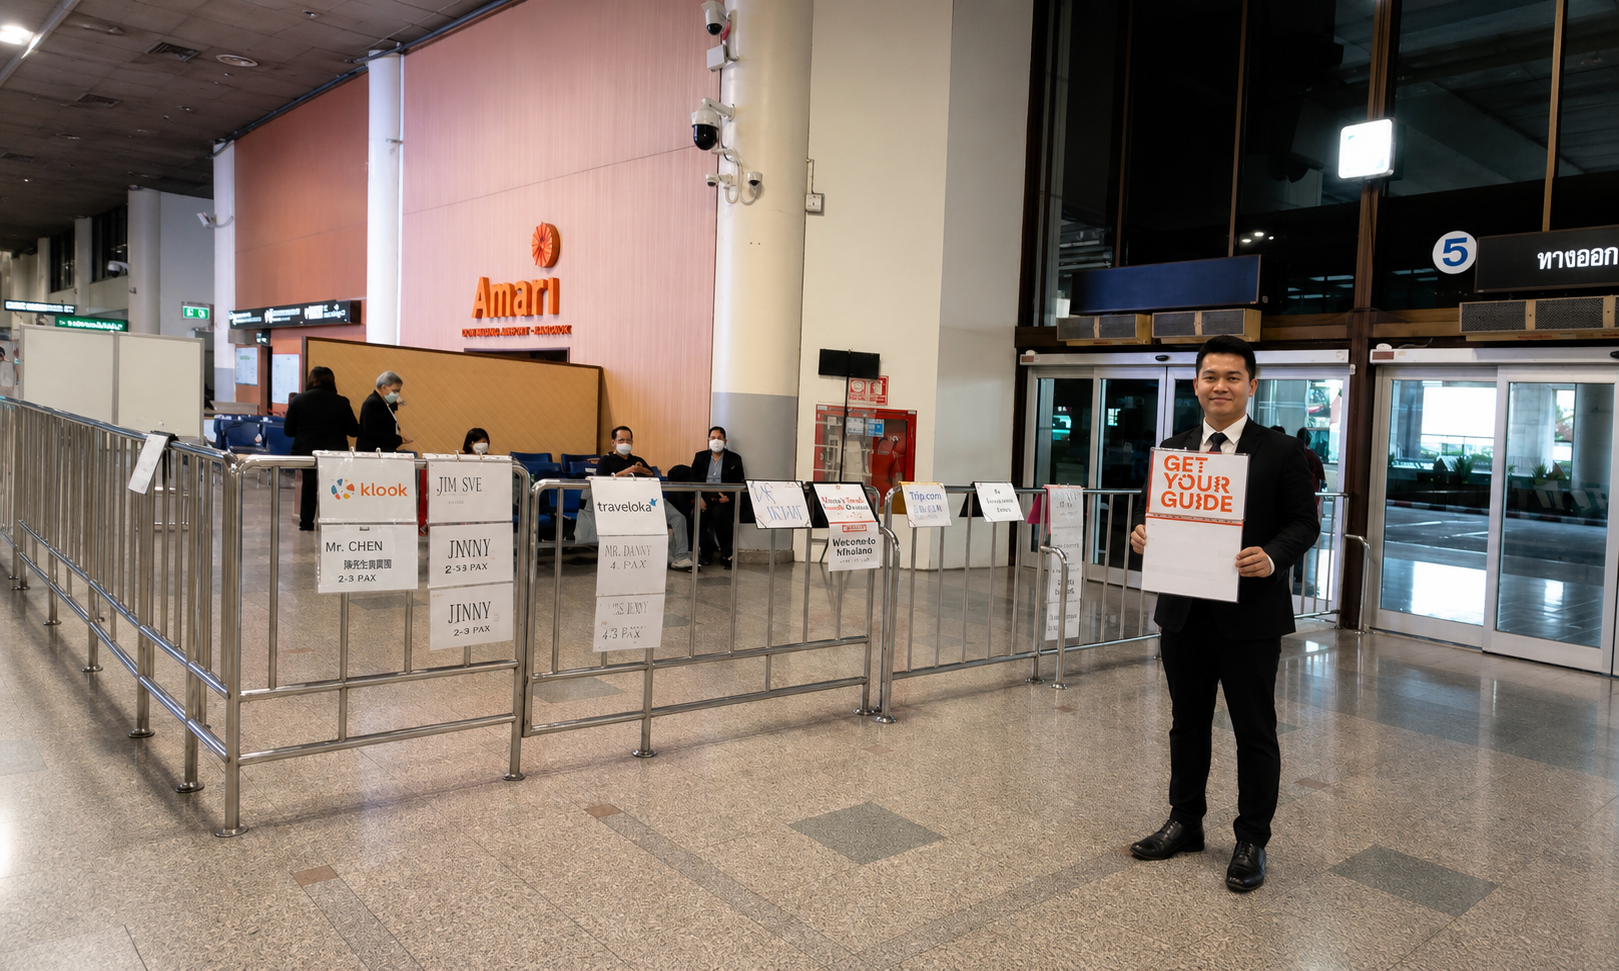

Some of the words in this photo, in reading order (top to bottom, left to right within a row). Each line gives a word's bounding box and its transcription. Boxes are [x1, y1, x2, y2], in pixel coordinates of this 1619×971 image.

[1442, 237, 1468, 266] 5
[1537, 246, 1618, 270] ทางออก
[471, 276, 560, 319] Amari
[1164, 455, 1208, 473] GET
[361, 482, 408, 497] klook
[437, 476, 456, 496] JIM
[1163, 472, 1230, 494] YOUR
[909, 491, 942, 502] Trip.com
[1160, 490, 1233, 513] GUIDE
[597, 500, 652, 513] traveloka
[326, 541, 344, 552] Mr.
[348, 540, 383, 552] CHEN
[470, 563, 488, 571] PAX
[338, 575, 354, 583] 2-3
[357, 574, 377, 582] PAX
[448, 600, 492, 624] JINNY
[453, 628, 470, 637] 2-3
[472, 625, 491, 634] PAX
